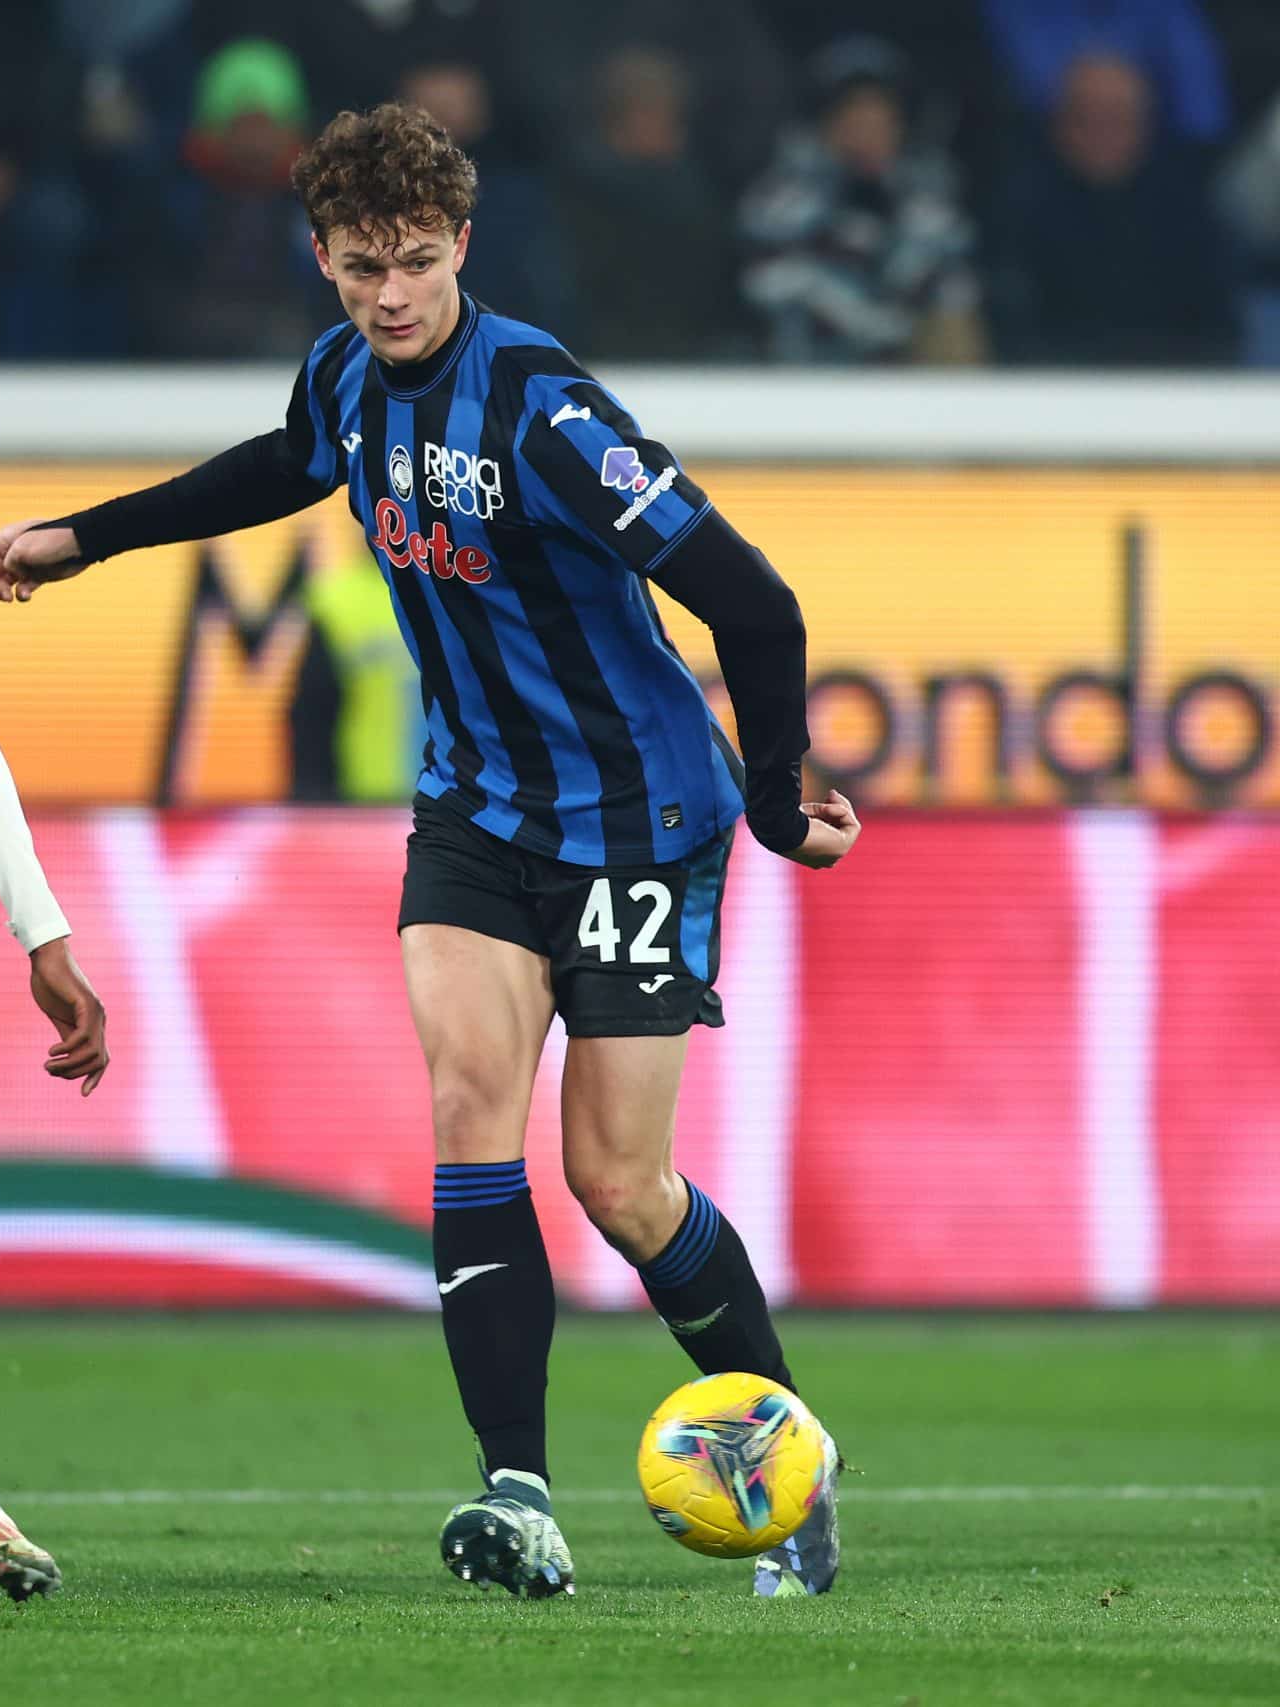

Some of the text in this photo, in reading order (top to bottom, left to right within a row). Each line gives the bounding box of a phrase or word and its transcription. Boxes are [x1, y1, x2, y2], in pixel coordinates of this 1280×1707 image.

[424, 441, 503, 493] RADICI
[425, 475, 505, 521] GROUP
[373, 498, 491, 583] Lete
[577, 877, 673, 964] 42
